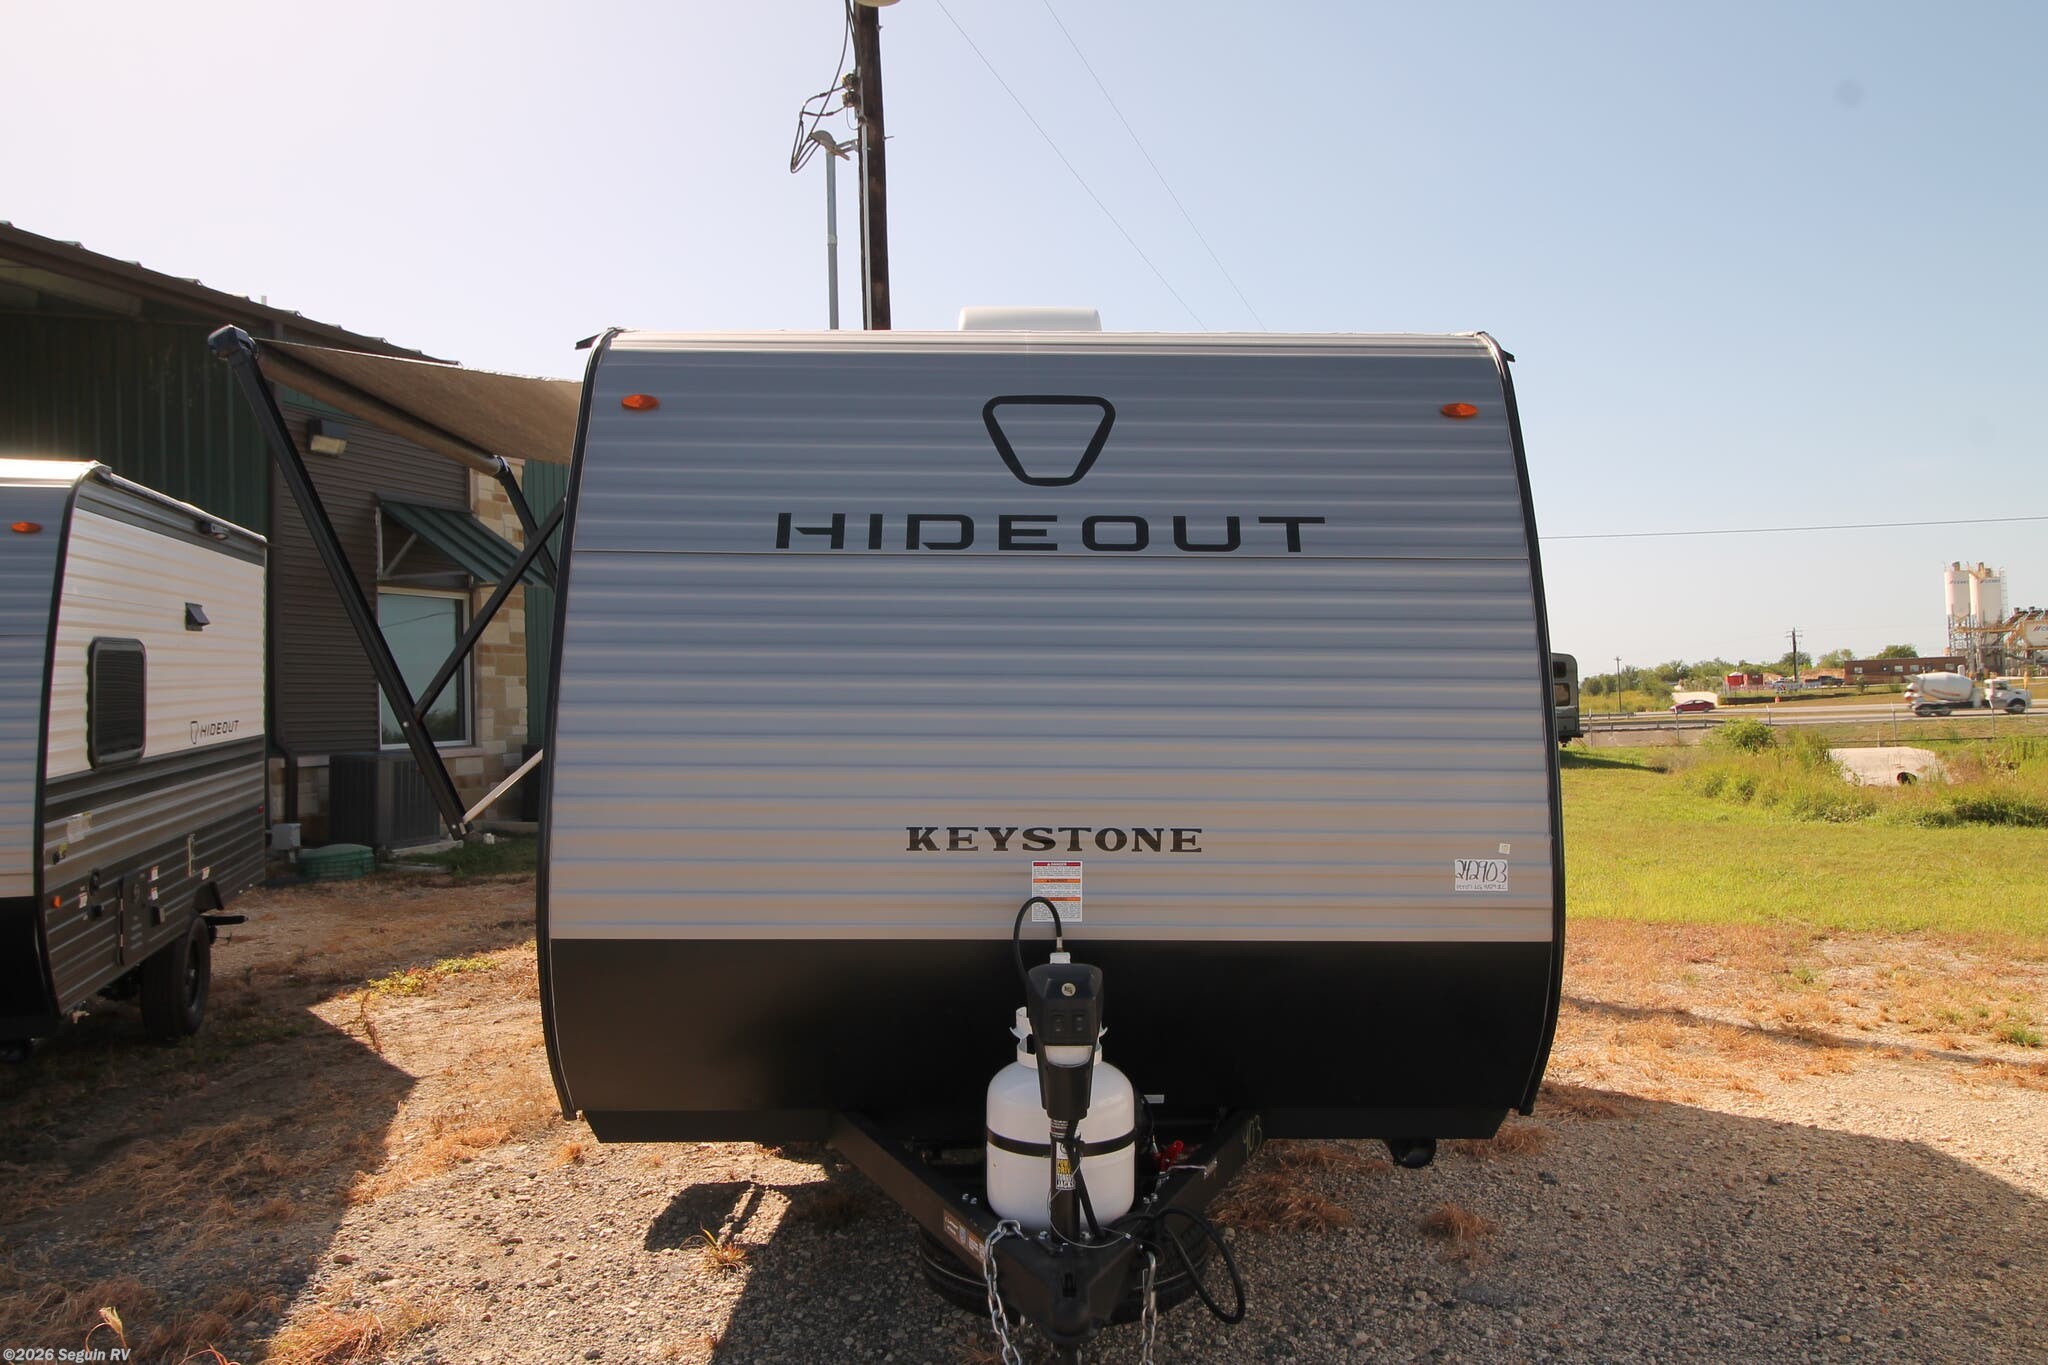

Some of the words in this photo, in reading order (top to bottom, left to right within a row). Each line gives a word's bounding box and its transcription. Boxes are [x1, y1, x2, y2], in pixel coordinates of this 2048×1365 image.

[776, 512, 1325, 553] HIDEOUT
[200, 720, 240, 738] HIDEOUT
[906, 827, 1202, 852] KEYSTONE
